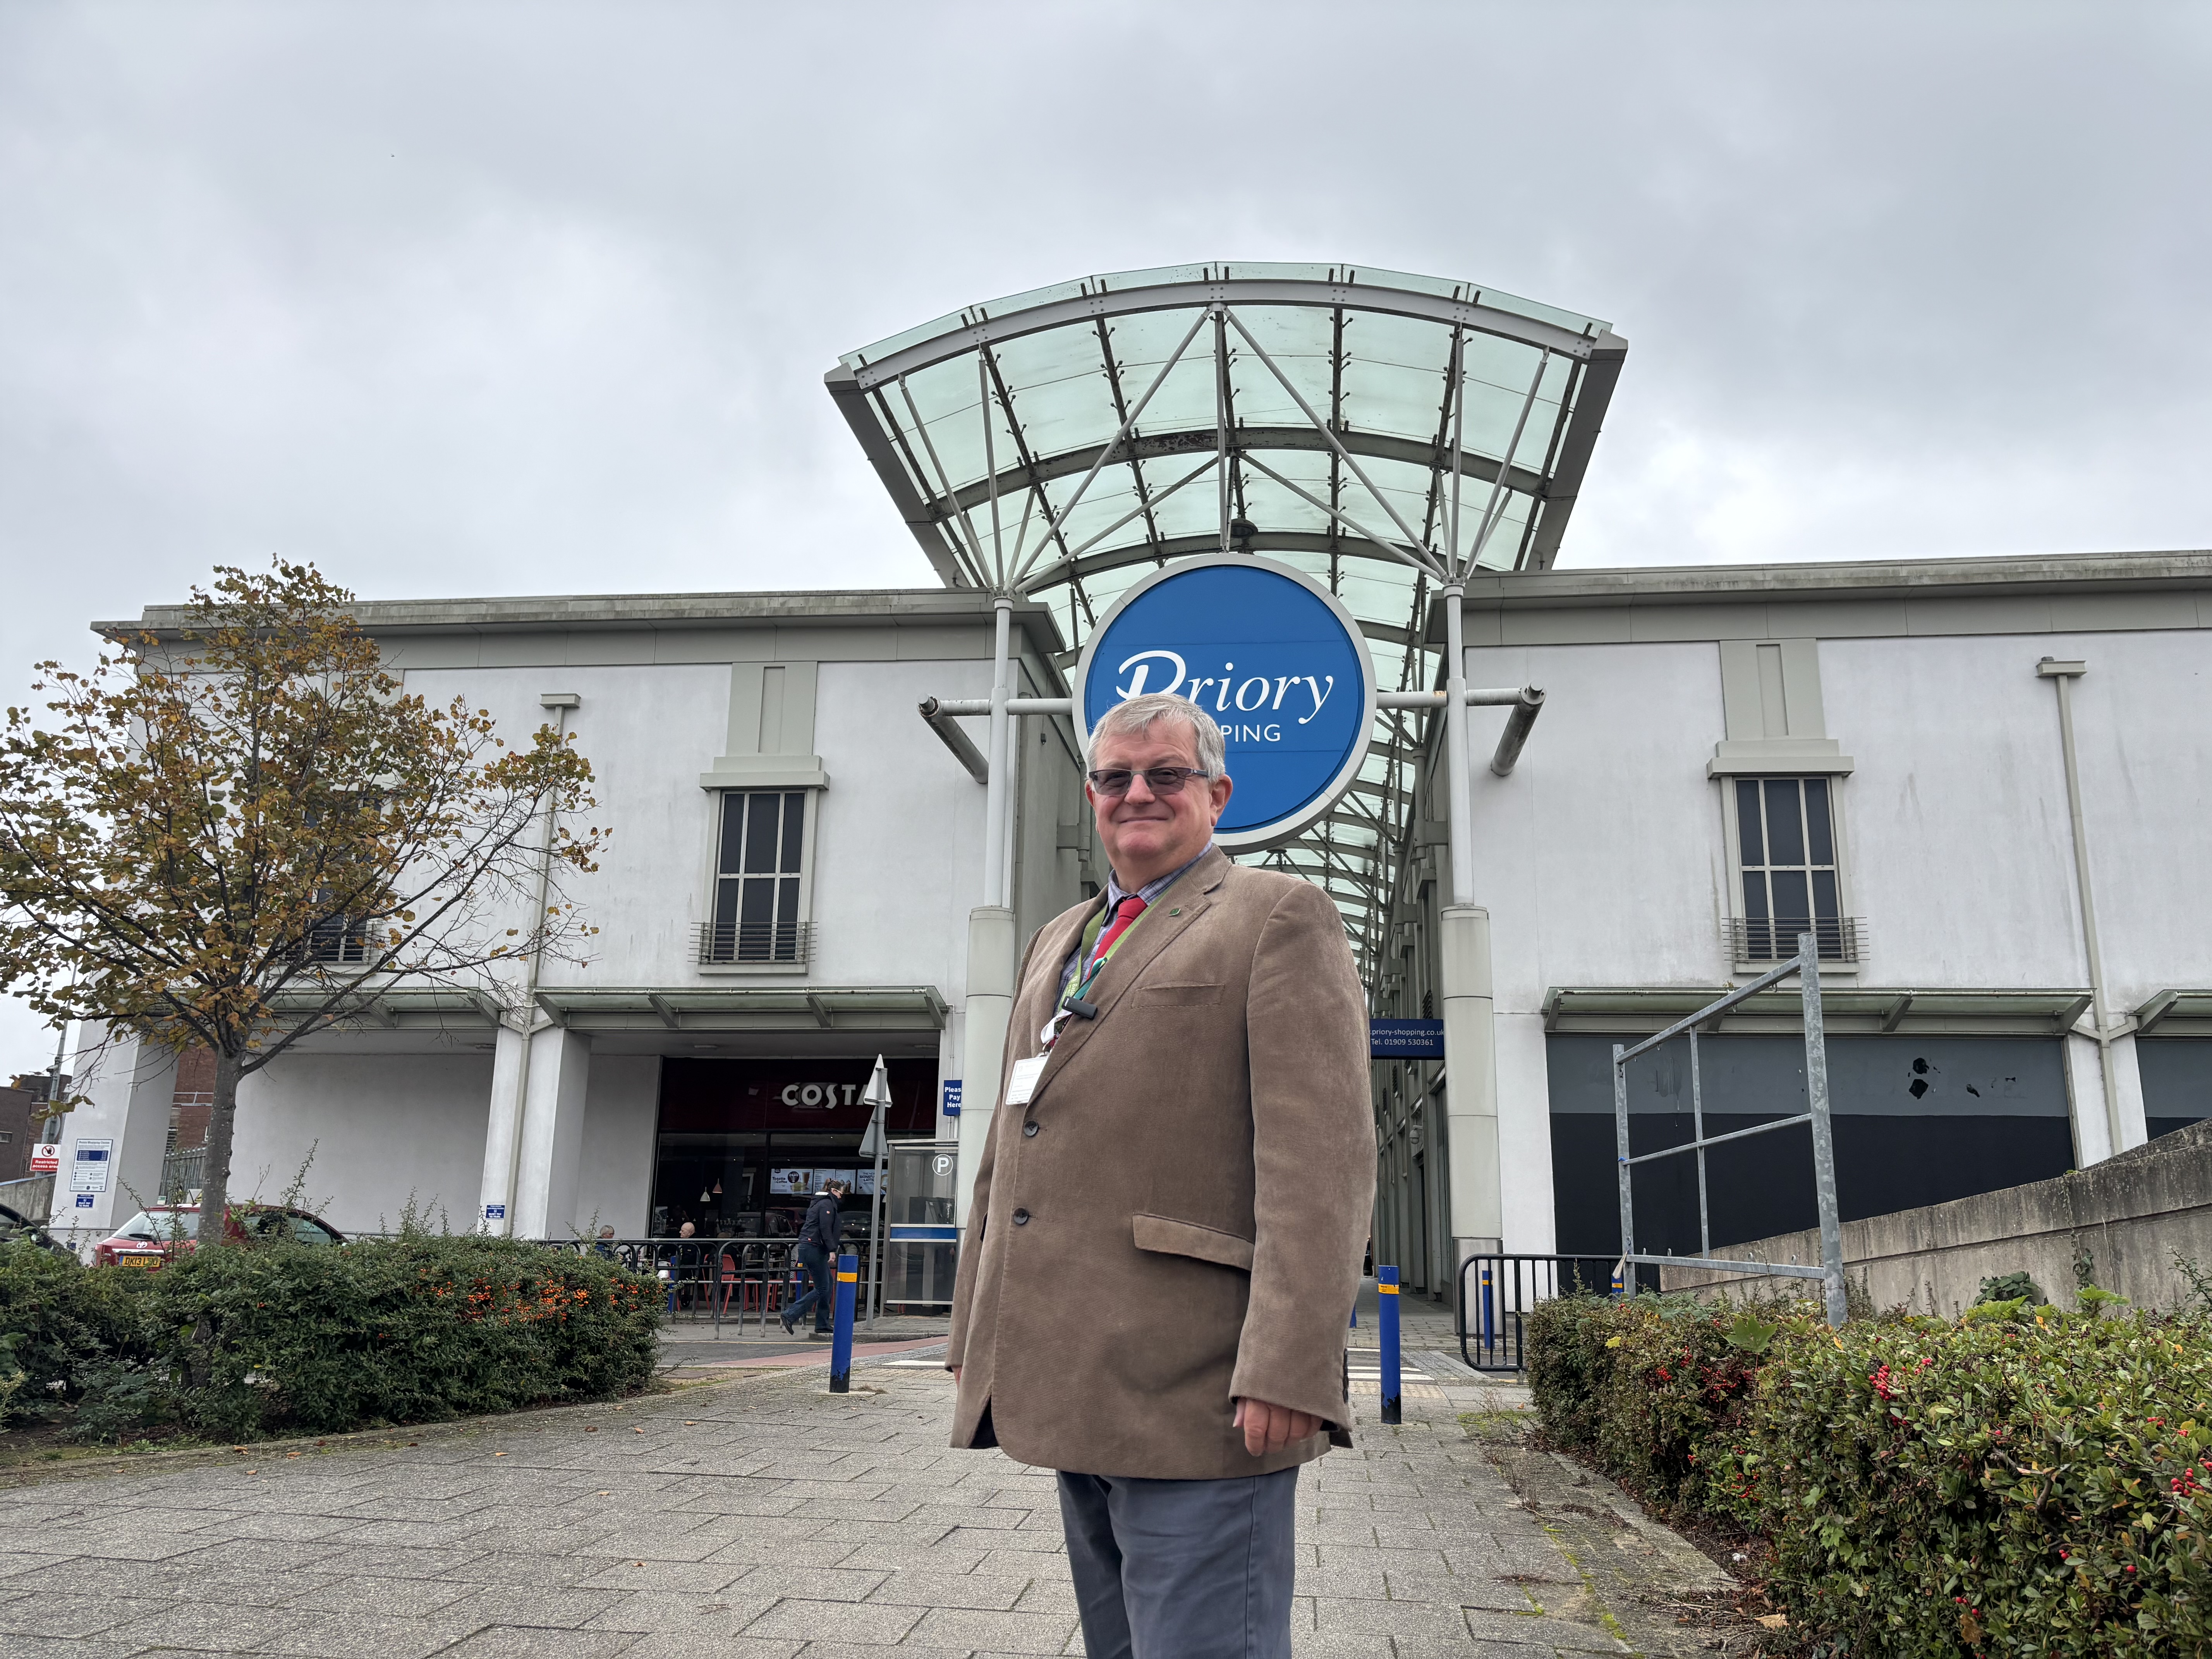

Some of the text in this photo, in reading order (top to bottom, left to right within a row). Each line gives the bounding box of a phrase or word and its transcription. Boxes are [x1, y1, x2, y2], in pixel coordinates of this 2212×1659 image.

[1116, 650, 1333, 724] Priory
[1221, 724, 1280, 742] PING
[1370, 1029, 1444, 1037] .priory-shopping.co.uk
[938, 1158, 949, 1172] P
[125, 1257, 141, 1266] DK13
